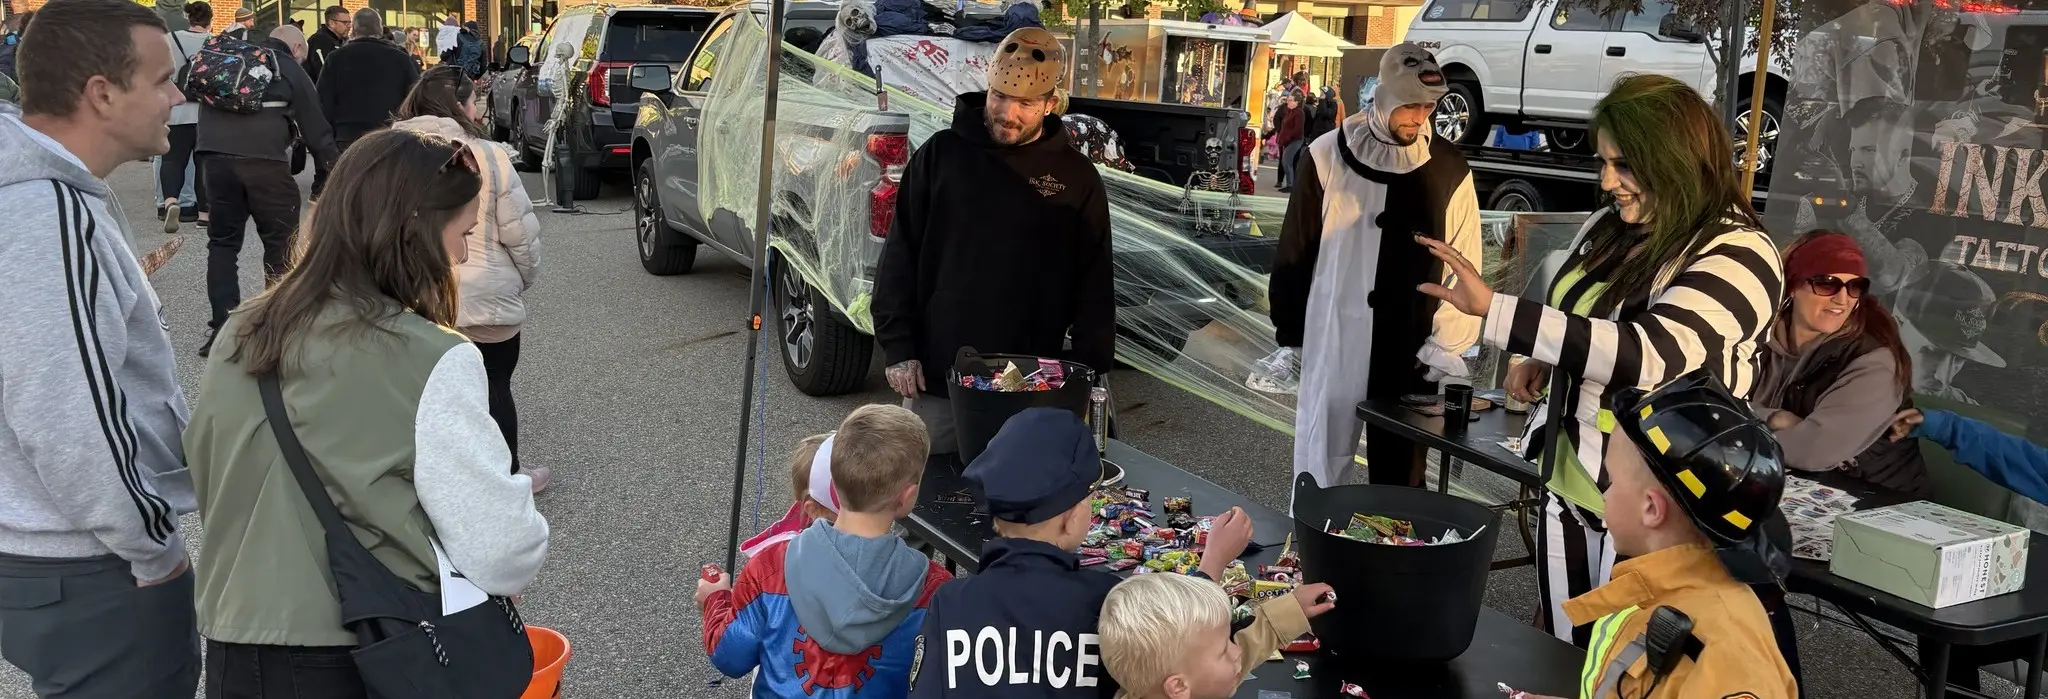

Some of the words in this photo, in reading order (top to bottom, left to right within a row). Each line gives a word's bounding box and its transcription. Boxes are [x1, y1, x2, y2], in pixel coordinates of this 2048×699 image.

[1927, 140, 2048, 229] INK
[1258, 588, 1289, 598] DOTS
[1980, 554, 1990, 593] HONEST
[946, 625, 1100, 689] POLICE
